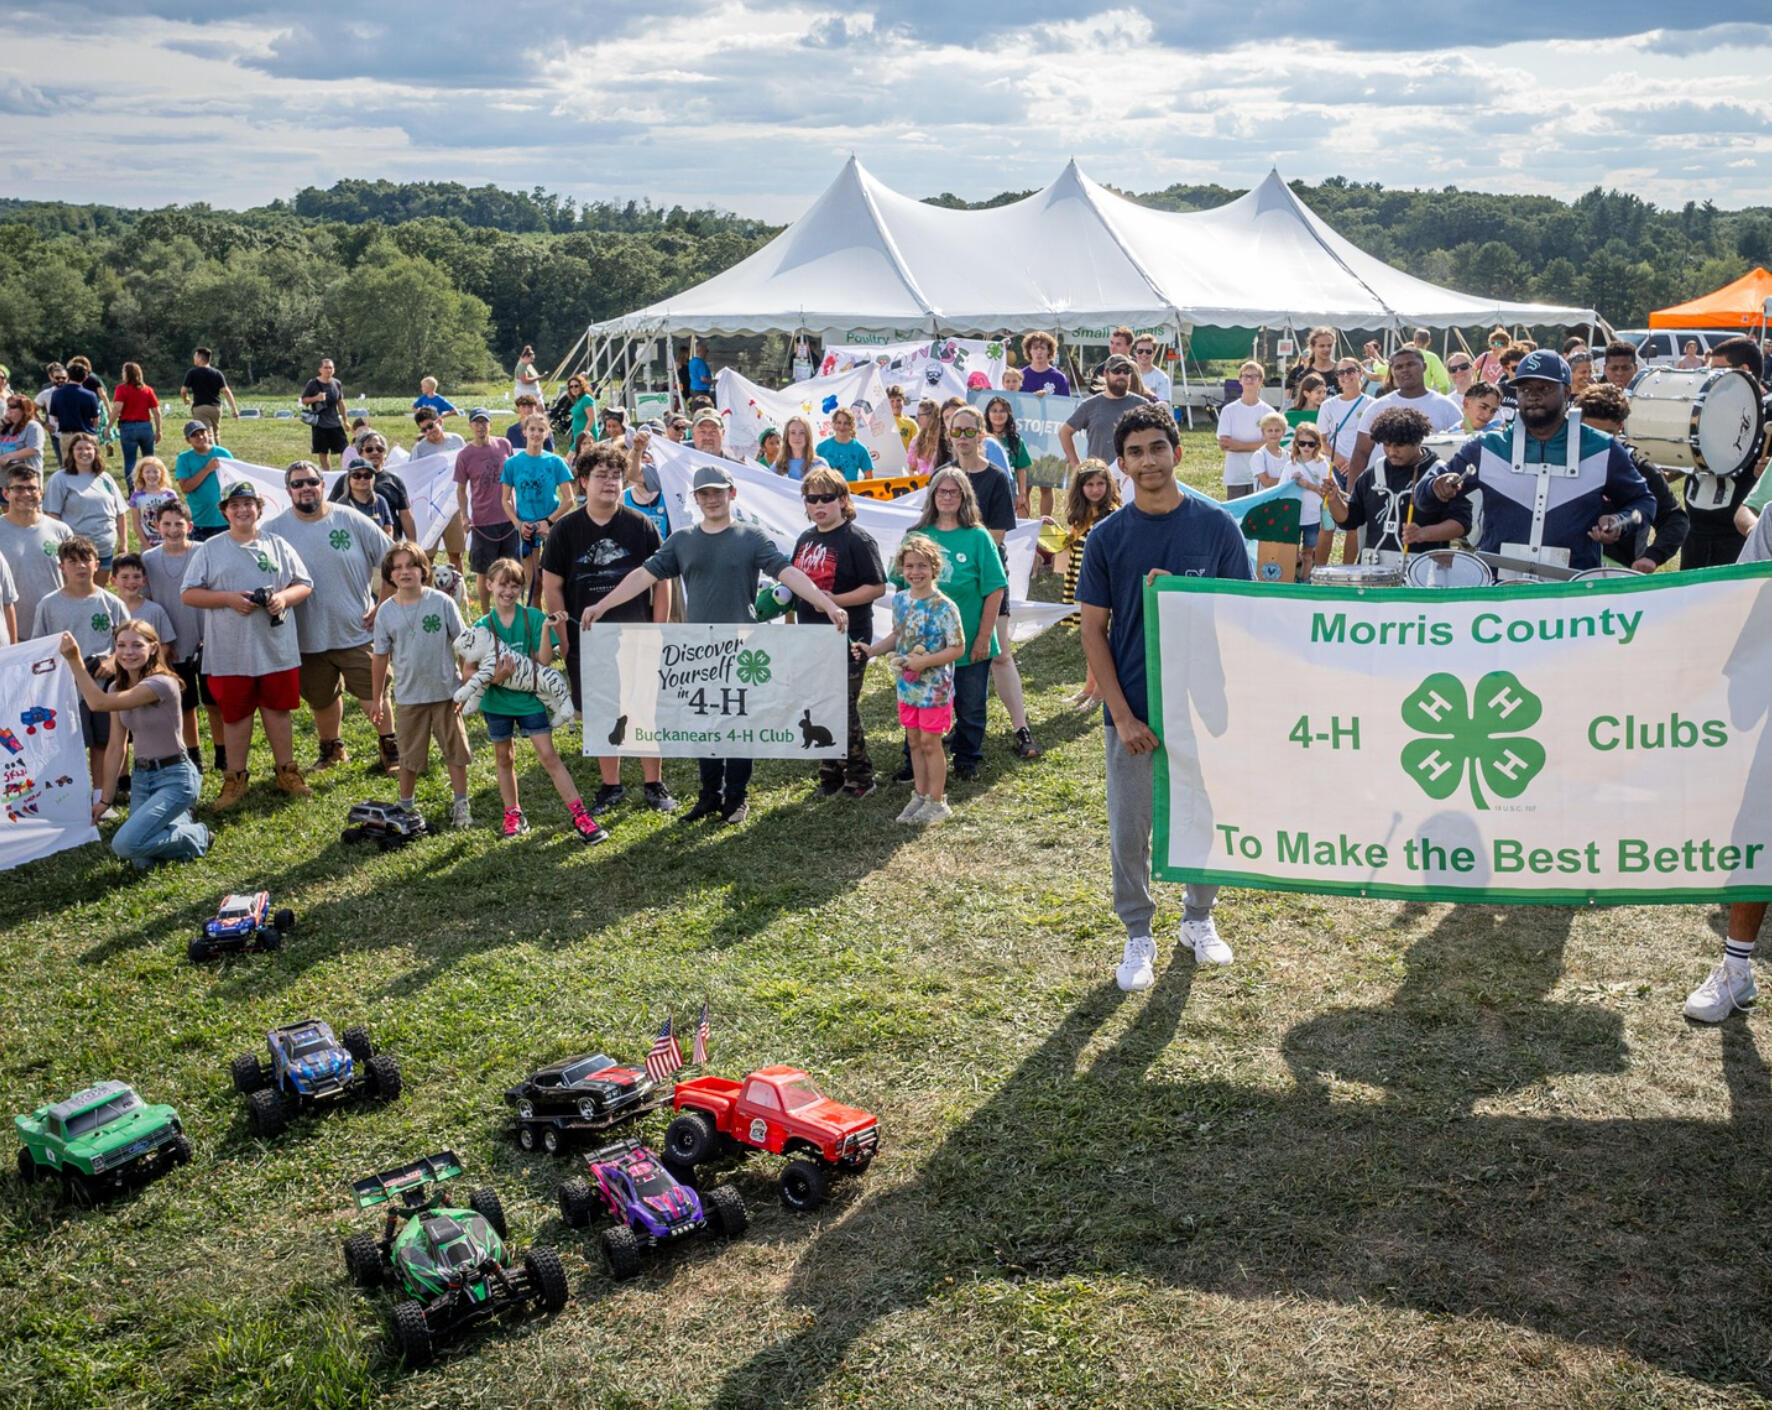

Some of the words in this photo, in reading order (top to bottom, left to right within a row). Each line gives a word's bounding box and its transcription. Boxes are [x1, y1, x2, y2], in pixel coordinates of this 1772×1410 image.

[846, 331, 890, 345] Poultry
[1071, 327, 1110, 338] Small
[1310, 612, 1454, 647] Morris
[1471, 608, 1643, 645] County
[662, 638, 745, 667] Discover
[658, 655, 735, 691] Yourself
[677, 687, 689, 699] in
[688, 687, 748, 716] 4-H
[1417, 689, 1453, 722] H
[1486, 685, 1524, 720] H
[635, 727, 722, 744] Buckanears
[726, 727, 754, 743] 4-H
[759, 727, 795, 744] Club
[1289, 715, 1361, 750] 4-H
[1588, 713, 1728, 751] Clubs
[1417, 749, 1453, 782] H
[1492, 749, 1529, 781] H
[1216, 824, 1262, 859] To
[1277, 830, 1388, 869] Make
[1404, 837, 1476, 873] the
[1494, 838, 1600, 874] Best
[1618, 838, 1765, 873] Better
